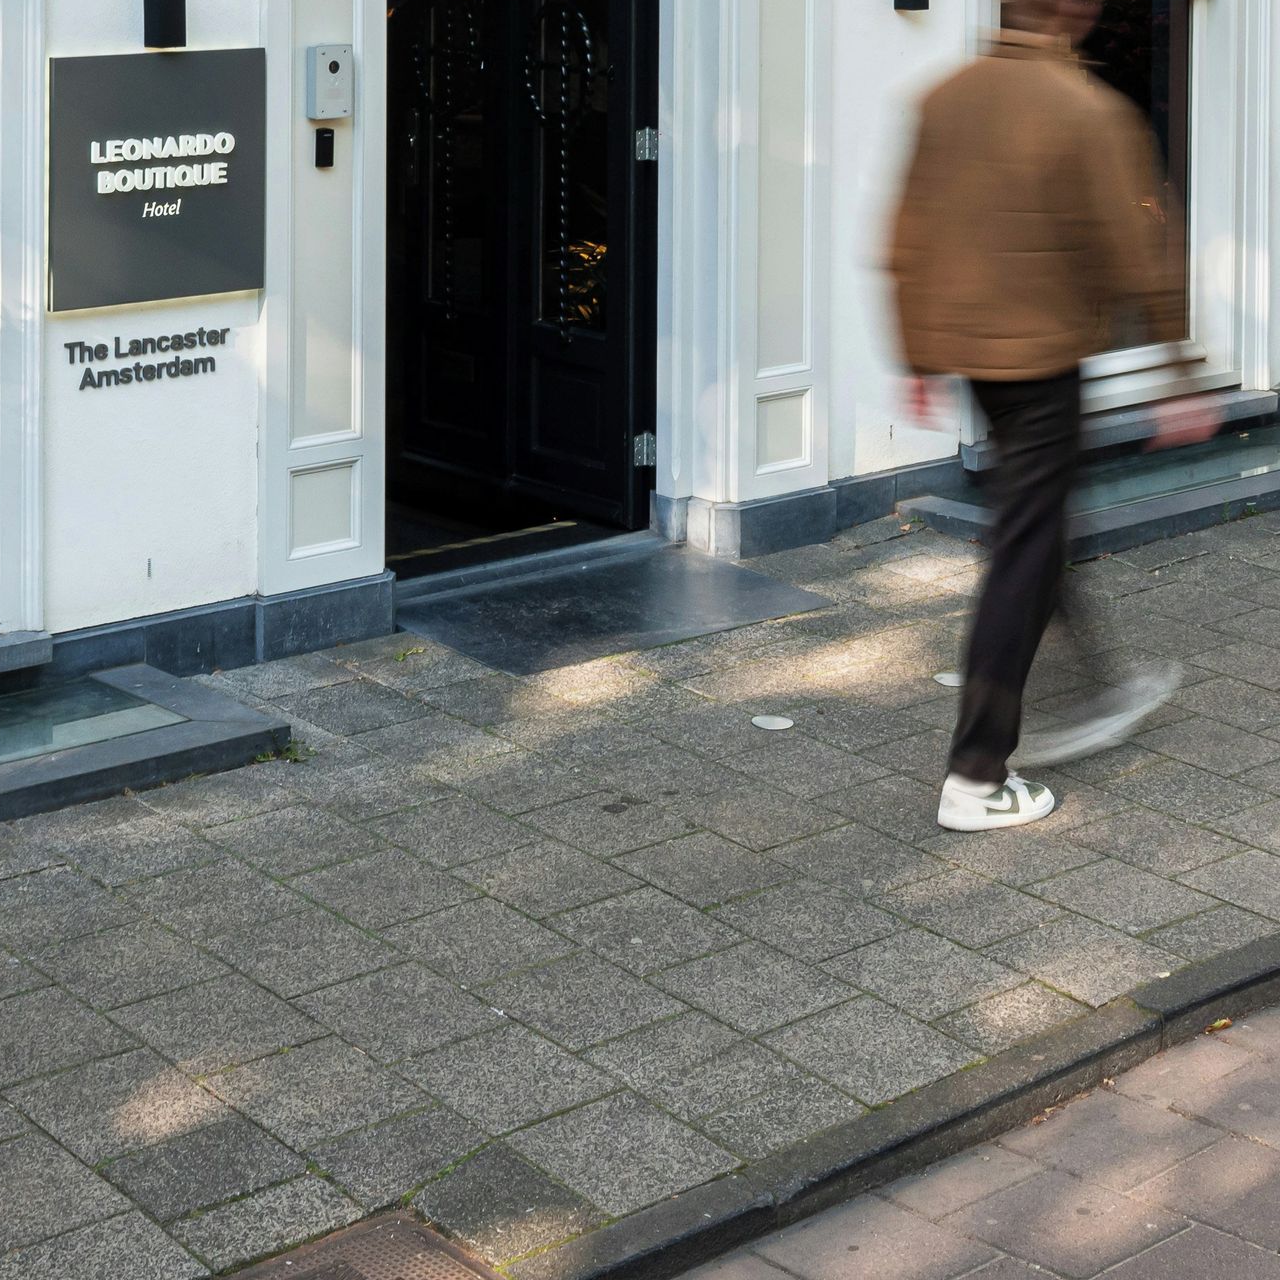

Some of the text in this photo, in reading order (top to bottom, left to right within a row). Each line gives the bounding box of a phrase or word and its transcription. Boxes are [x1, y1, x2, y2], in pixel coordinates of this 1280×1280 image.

[90, 131, 236, 164] LEONARDO
[97, 162, 228, 195] BOUTIQUE
[142, 198, 182, 219] Hotel
[64, 325, 231, 365] The Lancaster
[79, 354, 216, 391] Amsterdam
